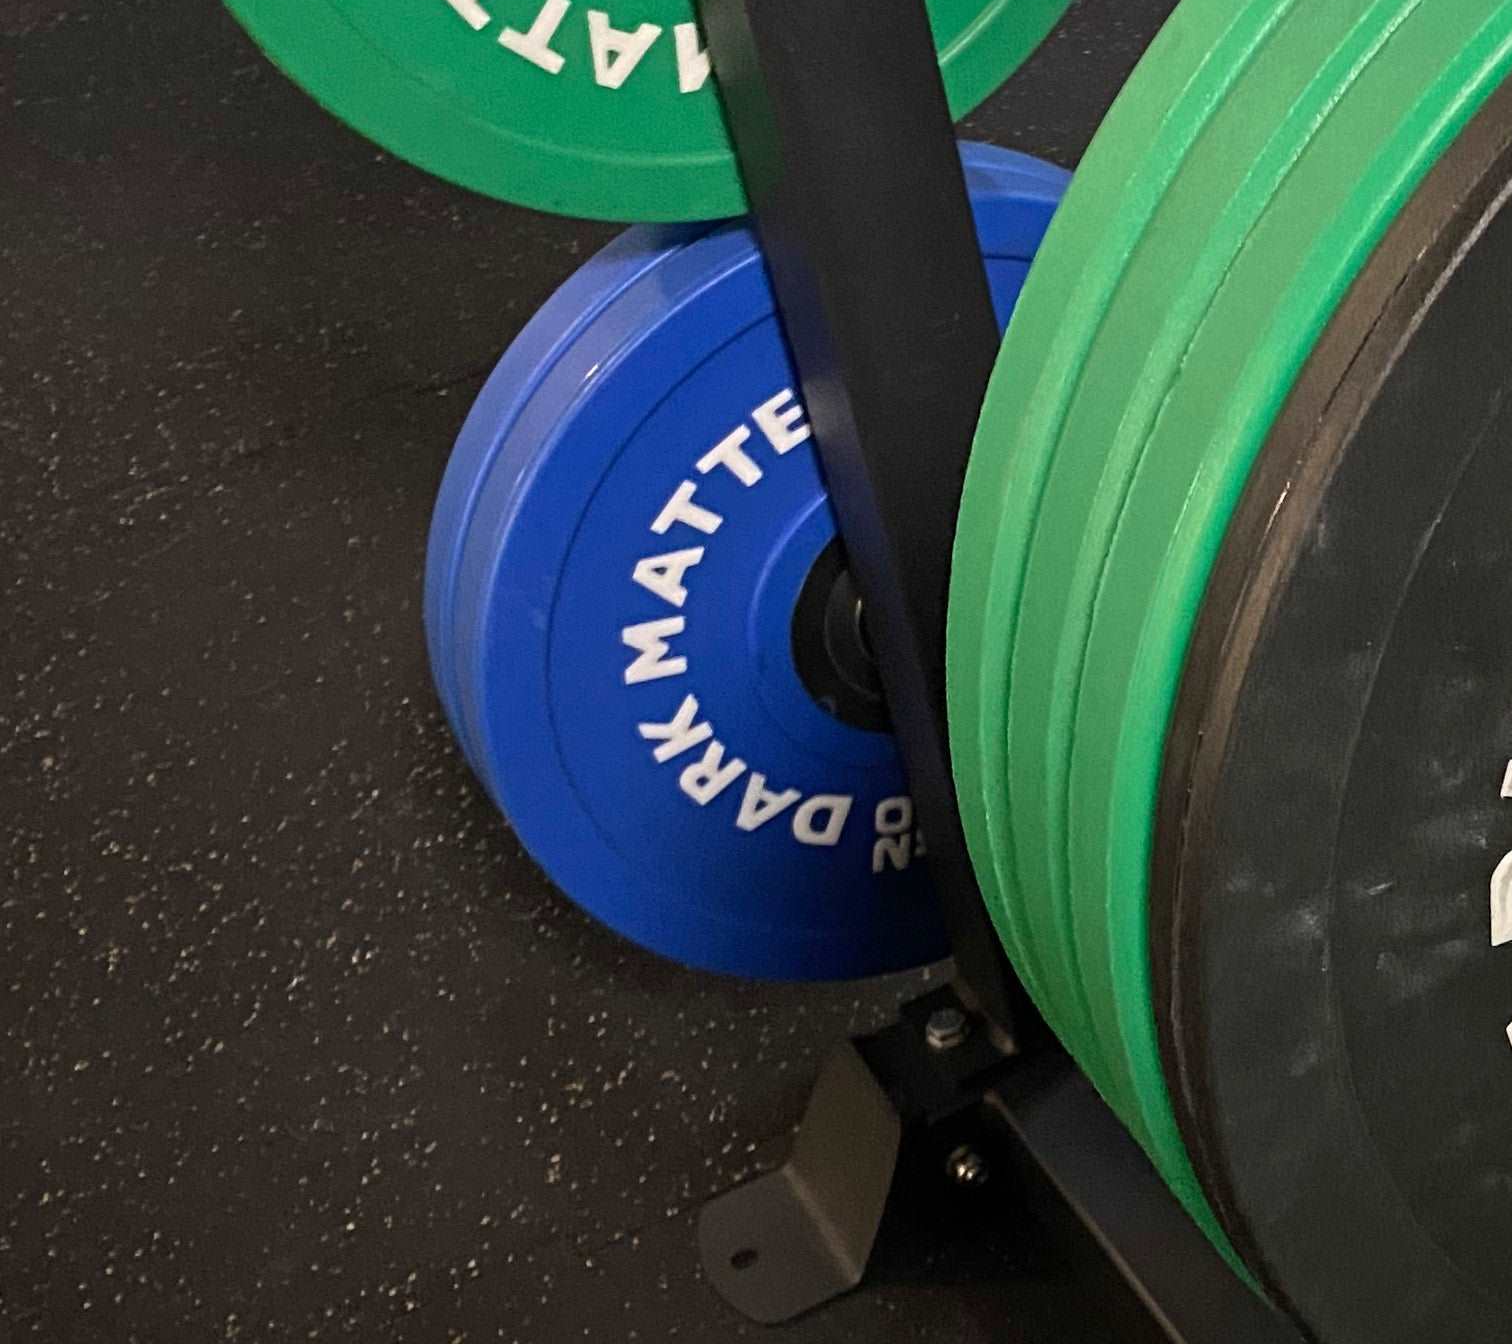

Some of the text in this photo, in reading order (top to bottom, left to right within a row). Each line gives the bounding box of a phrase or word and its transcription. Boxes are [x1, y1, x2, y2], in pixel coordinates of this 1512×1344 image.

[621, 388, 852, 845] DARK MATTE
[872, 796, 913, 874] 20
